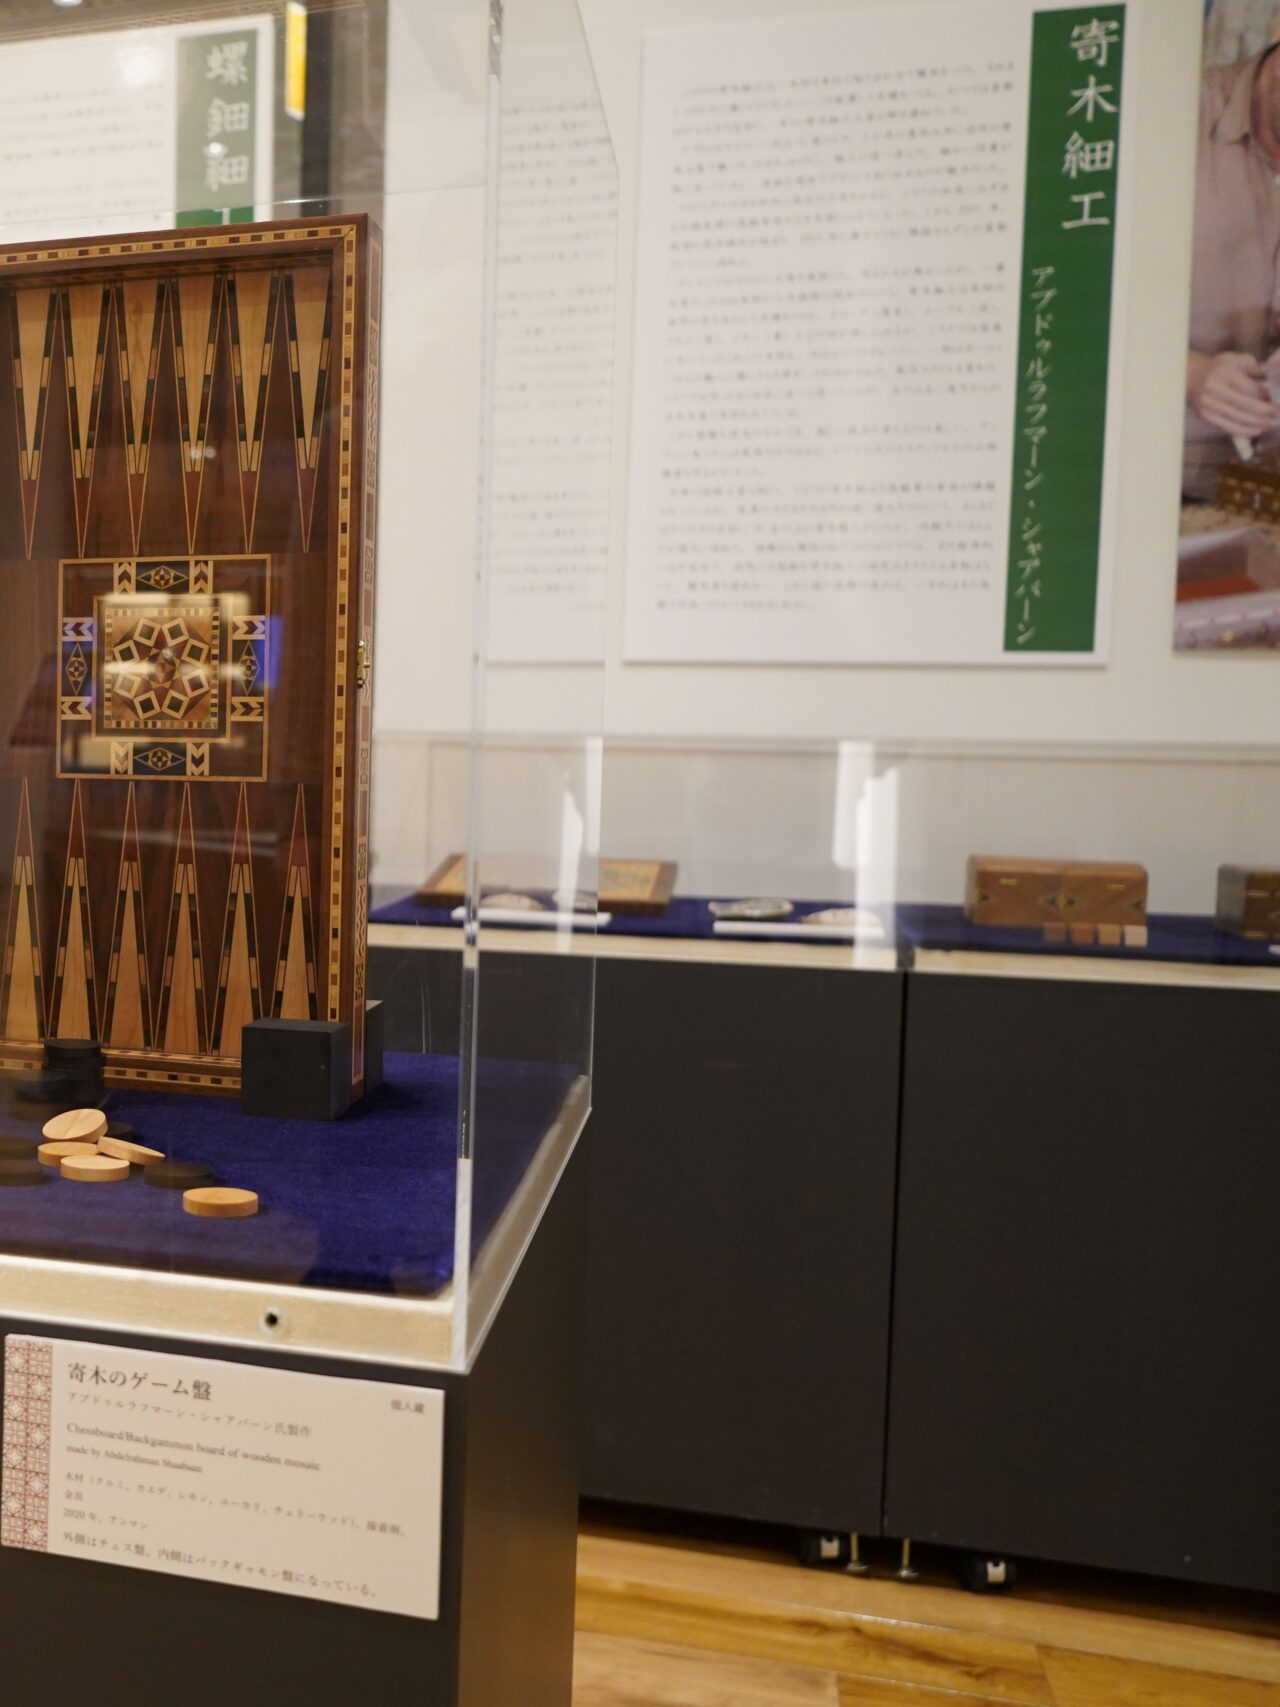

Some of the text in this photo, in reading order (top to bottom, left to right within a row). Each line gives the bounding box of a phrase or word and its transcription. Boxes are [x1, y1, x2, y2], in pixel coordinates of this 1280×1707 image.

[1062, 18, 1120, 229] 寄木細工
[67, 1362, 212, 1401] 寄木のゲーム盤
[65, 1444, 88, 1455] made
[90, 1448, 101, 1459] by
[196, 1442, 225, 1456] board
[227, 1447, 239, 1458] of
[241, 1452, 282, 1465] wooden
[284, 1457, 321, 1471] mosaic
